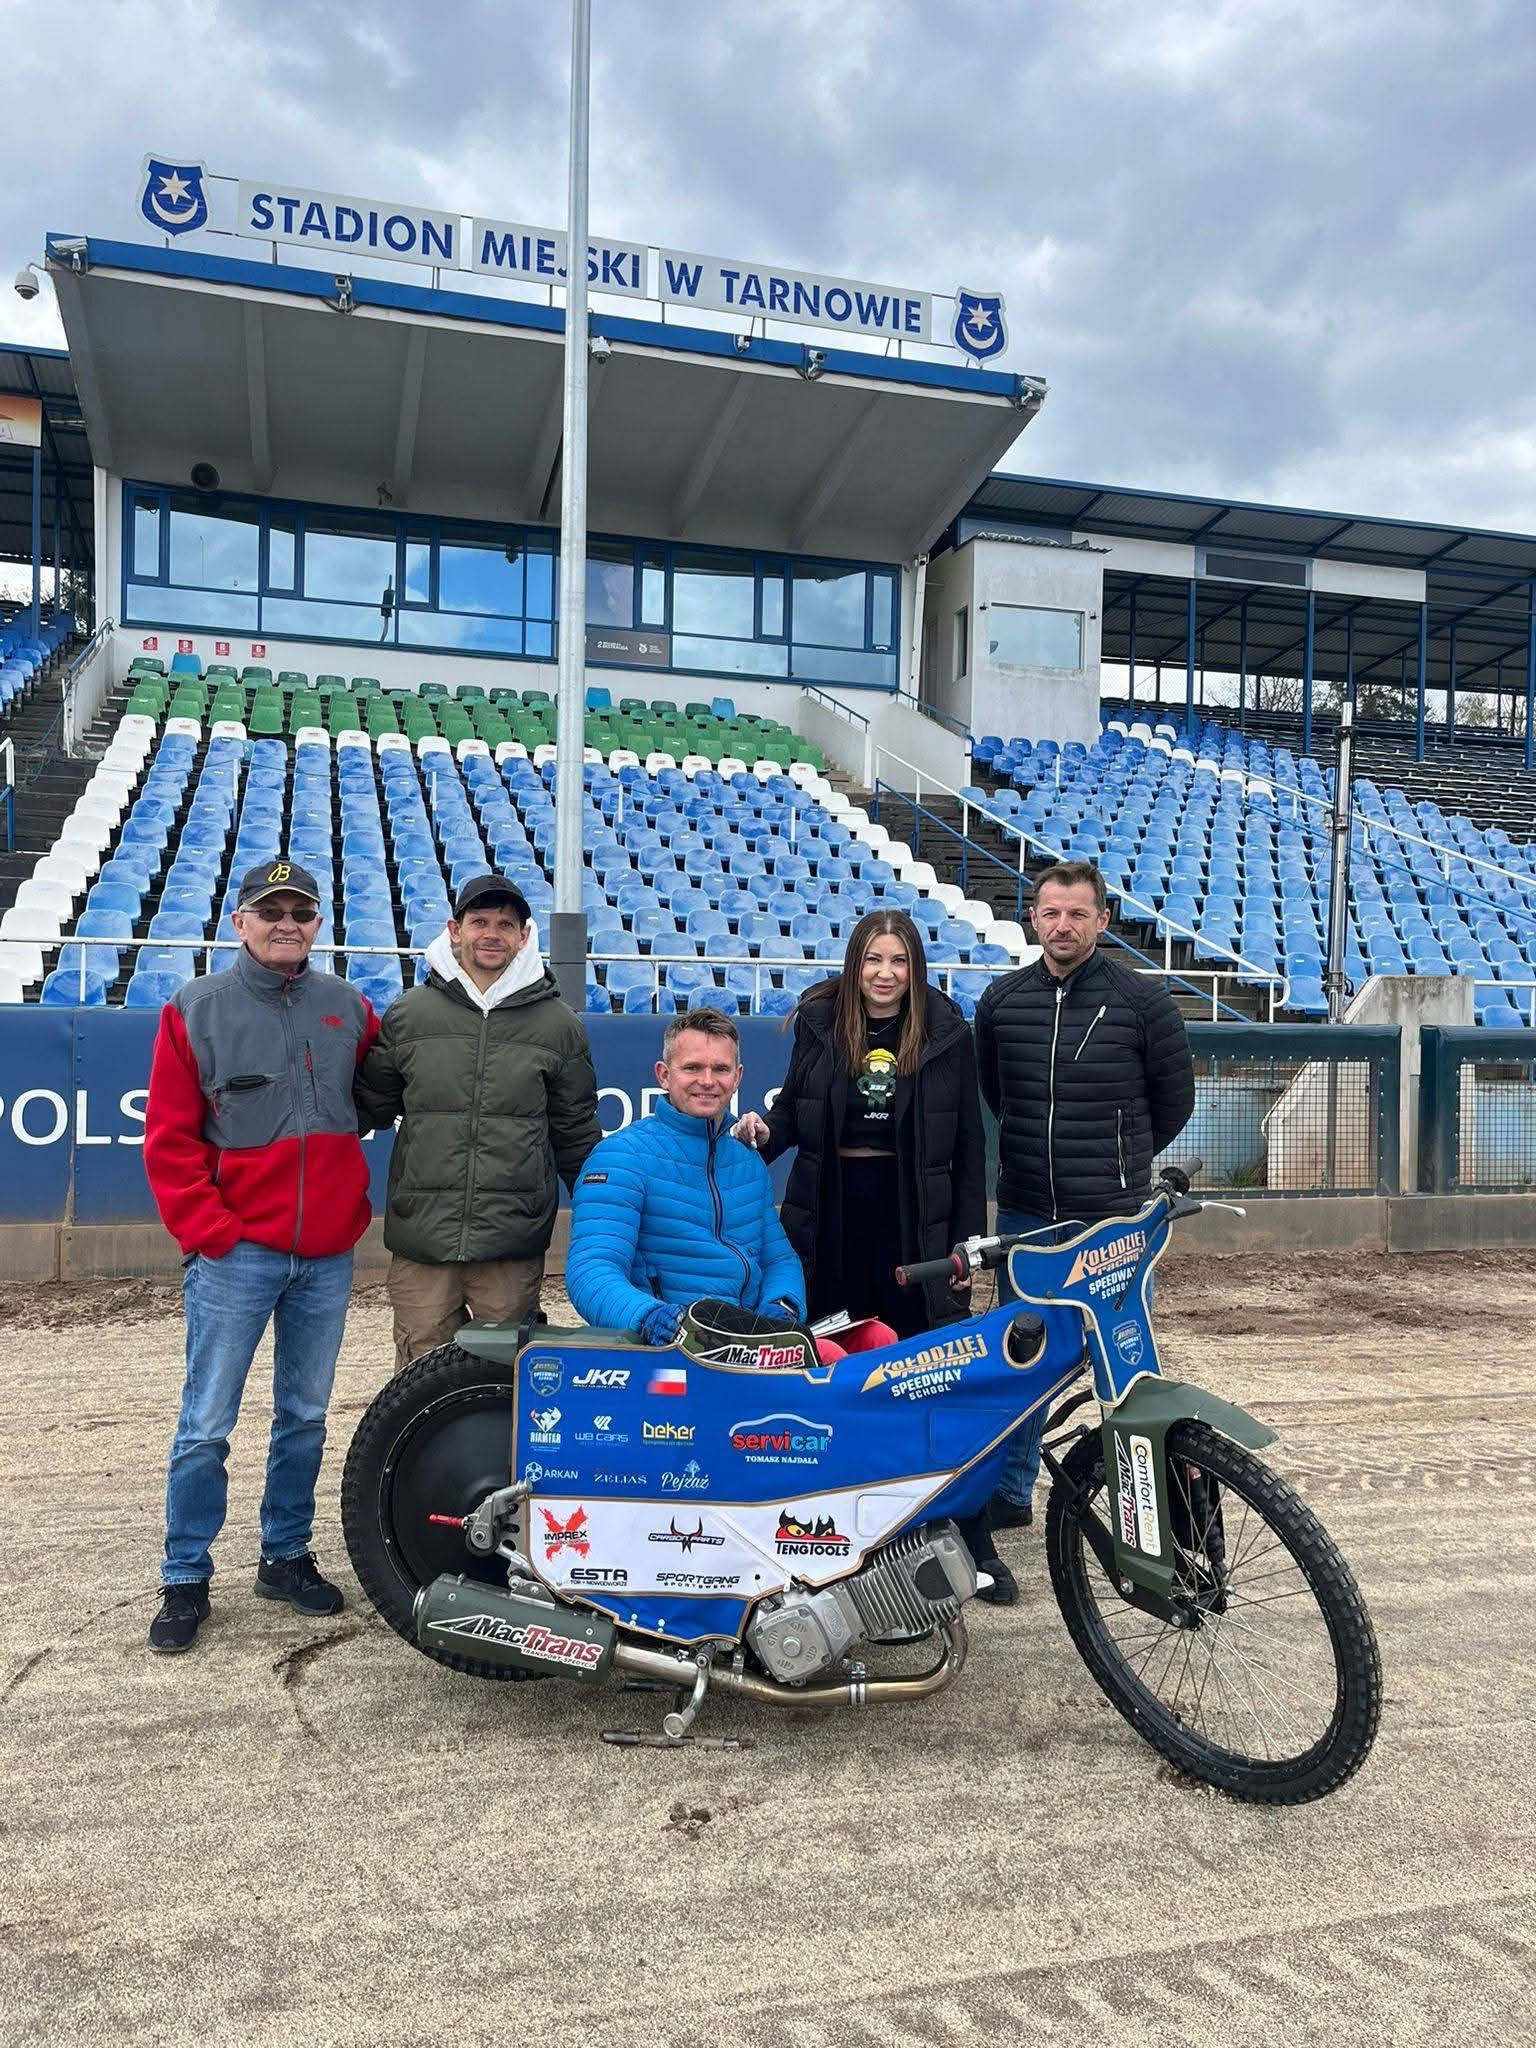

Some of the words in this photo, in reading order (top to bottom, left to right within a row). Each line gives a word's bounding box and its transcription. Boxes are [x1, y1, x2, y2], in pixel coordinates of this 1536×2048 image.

[251, 193, 454, 260] STADION
[665, 260, 704, 298] W
[720, 269, 922, 333] TARNOWIE
[863, 1112, 889, 1120] JKR
[1088, 1265, 1137, 1296] SPEEDWAY
[572, 1368, 631, 1386] JKR
[891, 1369, 962, 1397] SPEEDWAY
[908, 1383, 952, 1401] SCHOOL
[732, 1430, 831, 1452] servicar
[745, 1455, 780, 1463] TOMASZ
[543, 1469, 579, 1480] ARKAN
[544, 1531, 588, 1541] IMPREX
[775, 1540, 851, 1556] TENGTOOLS
[570, 1568, 628, 1581] ESTA
[656, 1573, 740, 1584] SPORTGANG
[474, 1616, 601, 1663] MacTrans
